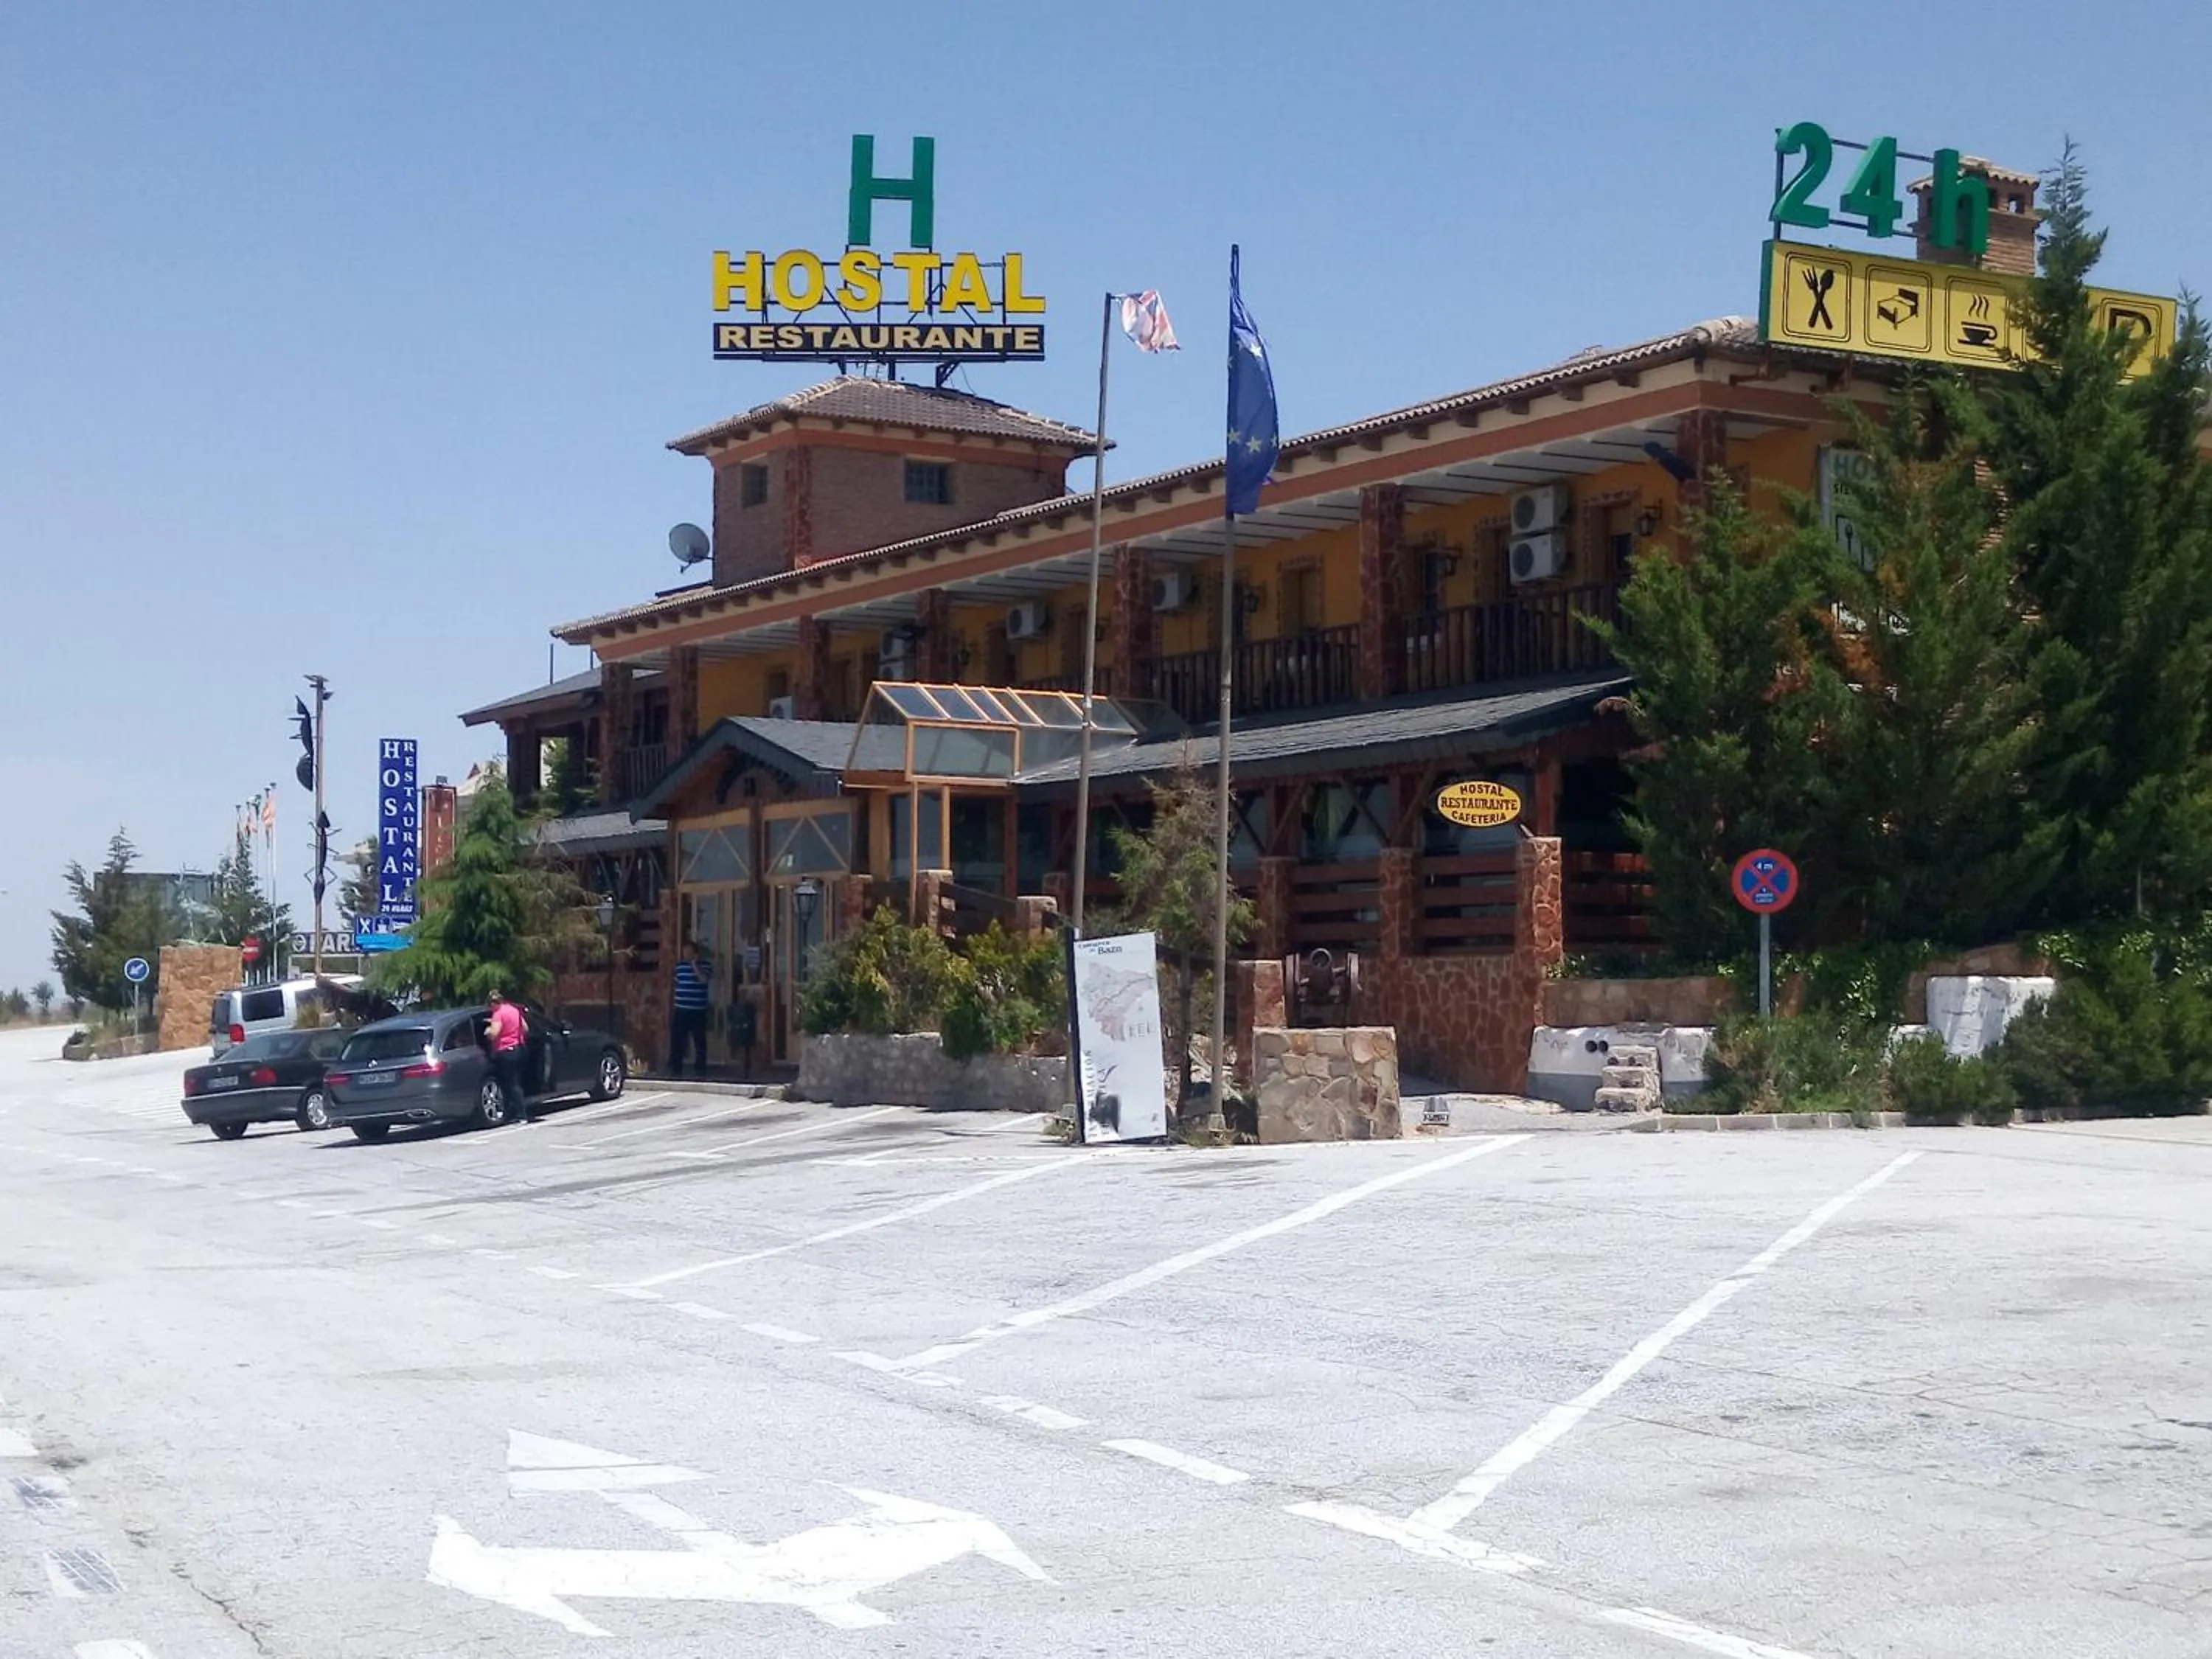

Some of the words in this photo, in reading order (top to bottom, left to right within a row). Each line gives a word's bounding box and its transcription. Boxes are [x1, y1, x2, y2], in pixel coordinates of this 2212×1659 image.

[848, 134, 934, 248] H
[712, 248, 1046, 313] HOSTAL
[718, 325, 1040, 350] RESTAURANTE
[1441, 797, 1517, 810] RESTAURANTE
[1459, 784, 1504, 796] HOSTAL
[382, 740, 400, 902] HOSTAL
[403, 741, 415, 902] RESTAURANTE
[1452, 811, 1506, 824] CAFETERIA
